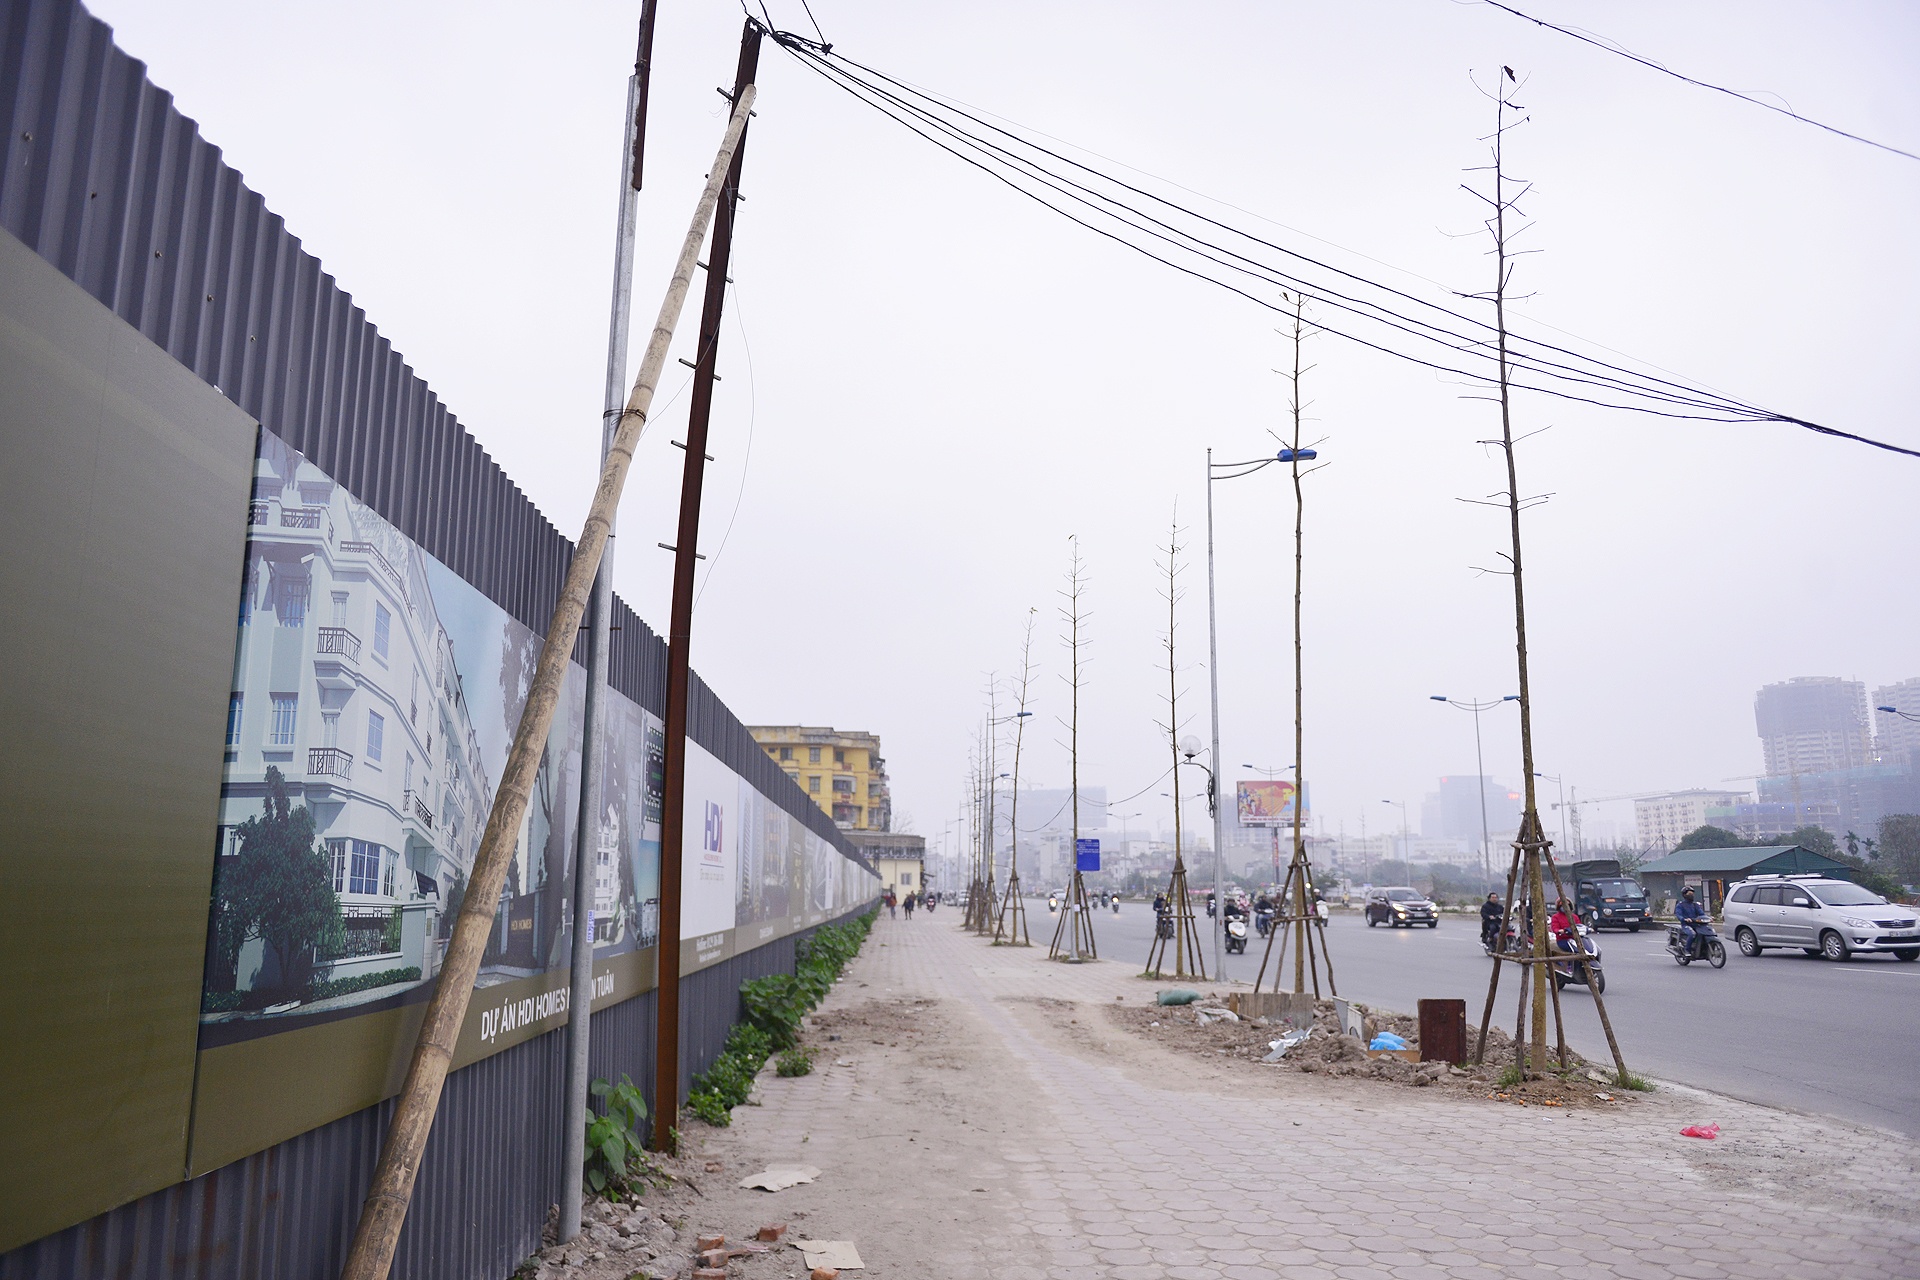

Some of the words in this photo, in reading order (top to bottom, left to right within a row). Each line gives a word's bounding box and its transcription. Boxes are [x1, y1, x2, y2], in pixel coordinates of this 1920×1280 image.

[481, 1007, 500, 1044] DỰ
[500, 997, 516, 1033] ÁN
[518, 997, 535, 1027] HDI
[536, 987, 566, 1021] HOMES
